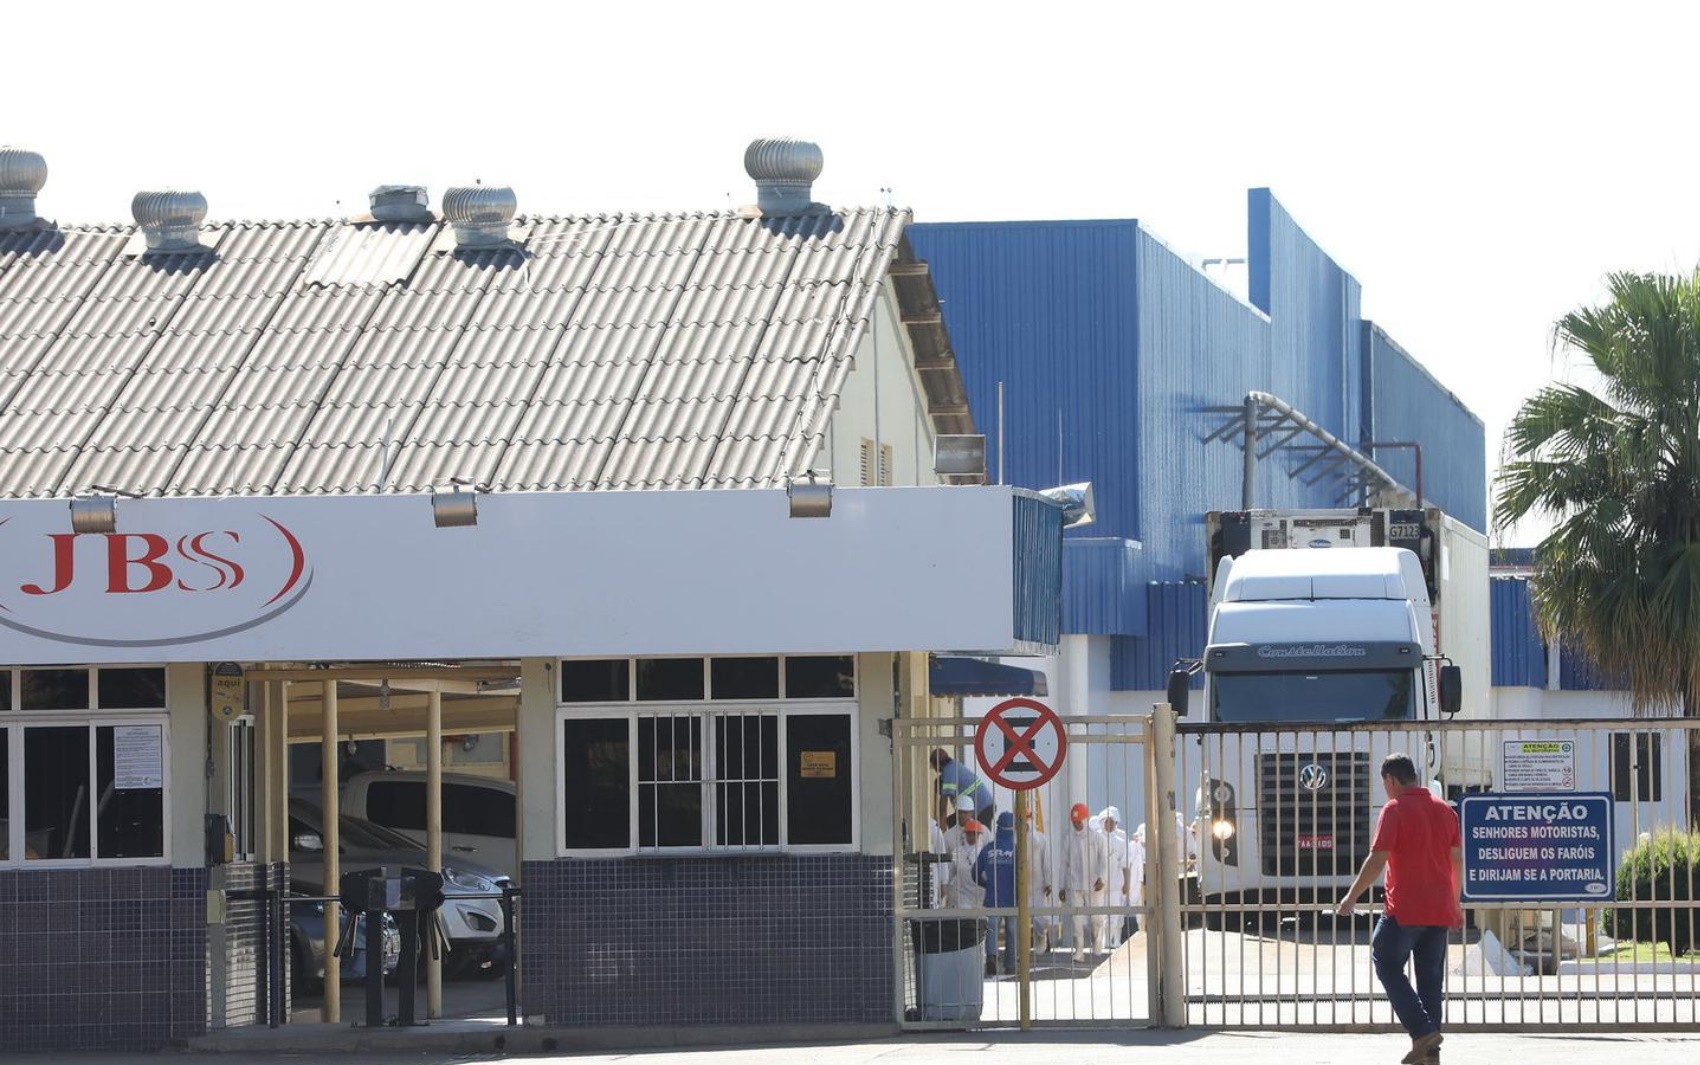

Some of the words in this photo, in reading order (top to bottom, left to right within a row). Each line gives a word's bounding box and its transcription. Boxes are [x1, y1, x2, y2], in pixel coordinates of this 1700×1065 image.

[20, 531, 245, 595] JBS
[1484, 801, 1588, 823] ATENÇÃO
[1472, 826, 1528, 839] SENHORES
[1530, 825, 1600, 840] MOTORISTAS,
[1478, 847, 1538, 860] DESLIGUEM
[1541, 847, 1555, 860] OS
[1557, 844, 1595, 859] FARÓIS
[1470, 870, 1476, 881] E
[1478, 869, 1521, 881] DIRIJAM
[1523, 869, 1537, 881] SE
[1539, 869, 1547, 881] A
[1550, 868, 1605, 880] PORTARIA.
